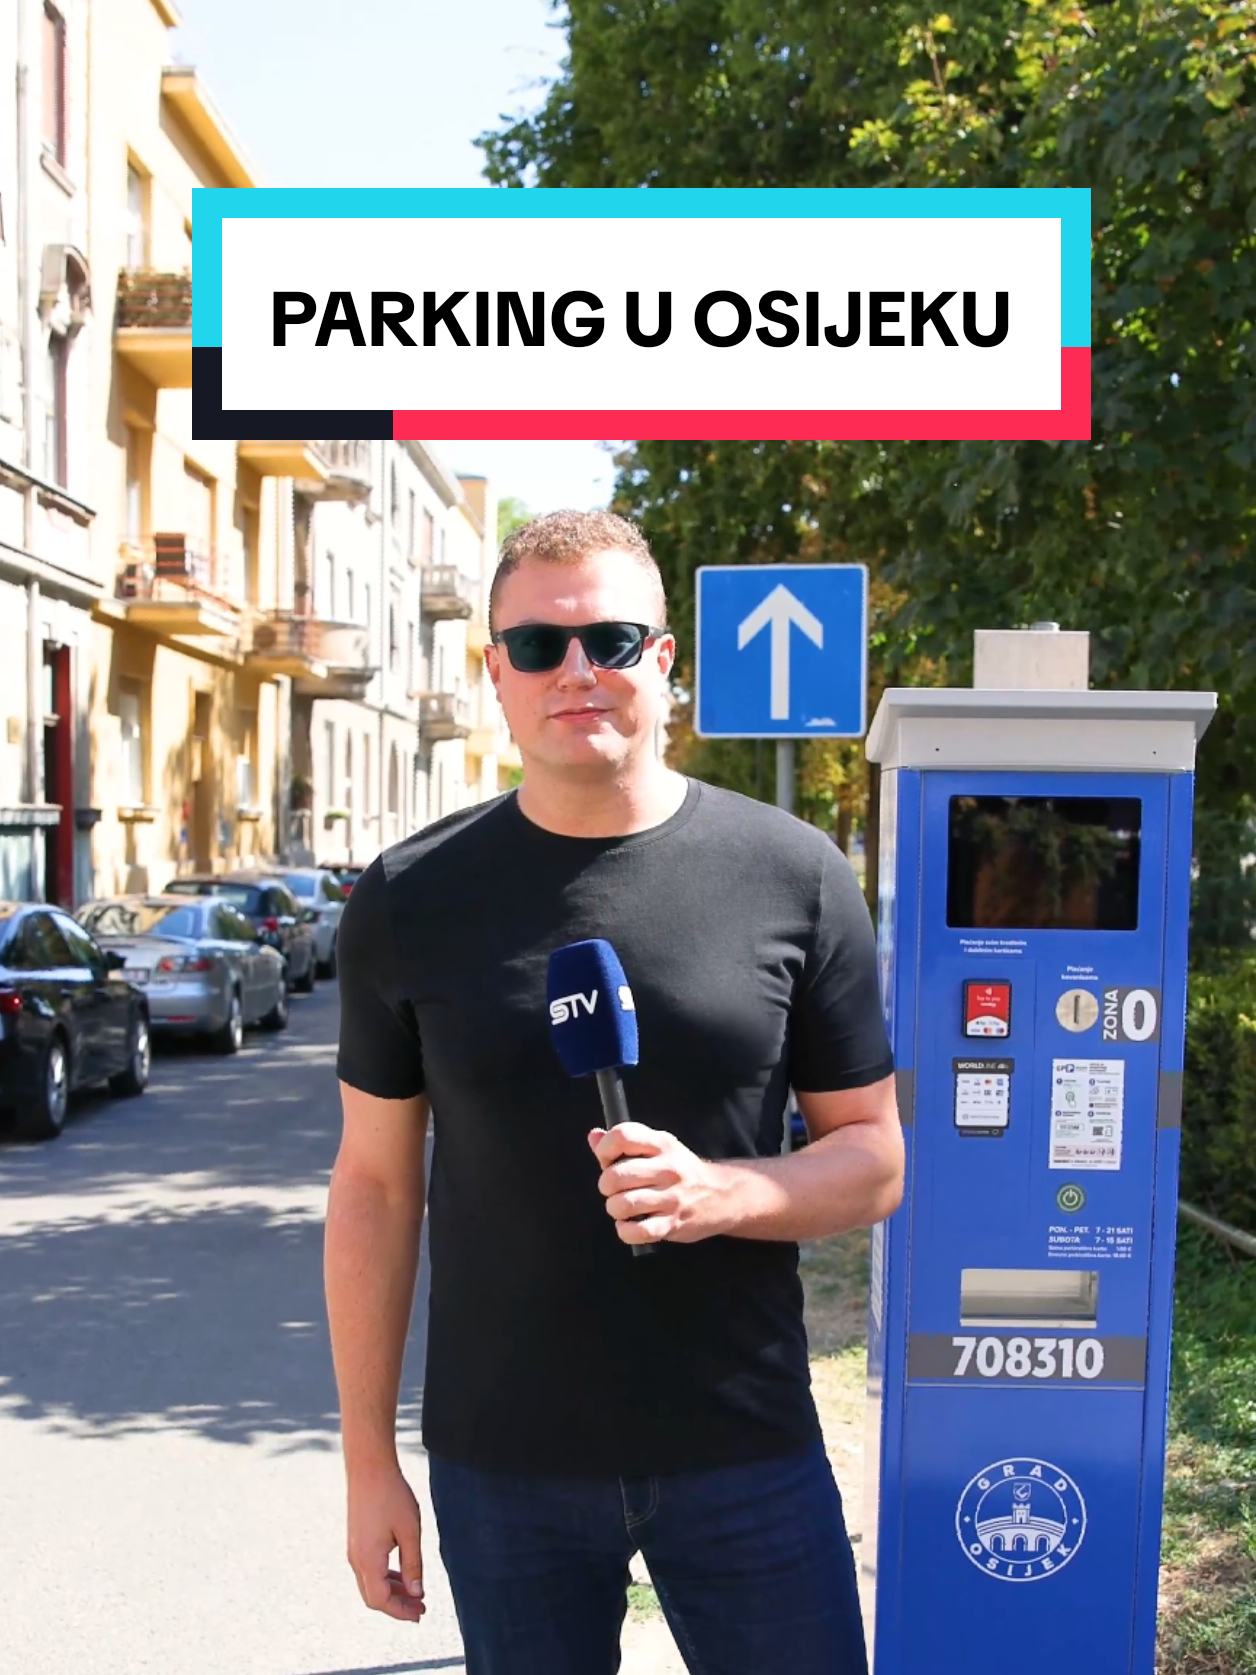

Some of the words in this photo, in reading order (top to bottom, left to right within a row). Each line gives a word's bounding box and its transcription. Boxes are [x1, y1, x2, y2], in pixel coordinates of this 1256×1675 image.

[549, 989, 598, 1026] STV
[1103, 989, 1119, 1040] ZONA
[1122, 989, 1157, 1042] 0
[1095, 1226, 1101, 1234] 7
[1116, 1227, 1133, 1235] SATI
[1095, 1236, 1101, 1244] 7
[952, 1336, 1104, 1379] 708310
[977, 1464, 1068, 1491] GRAD
[969, 1543, 1071, 1577] OSIJEK
